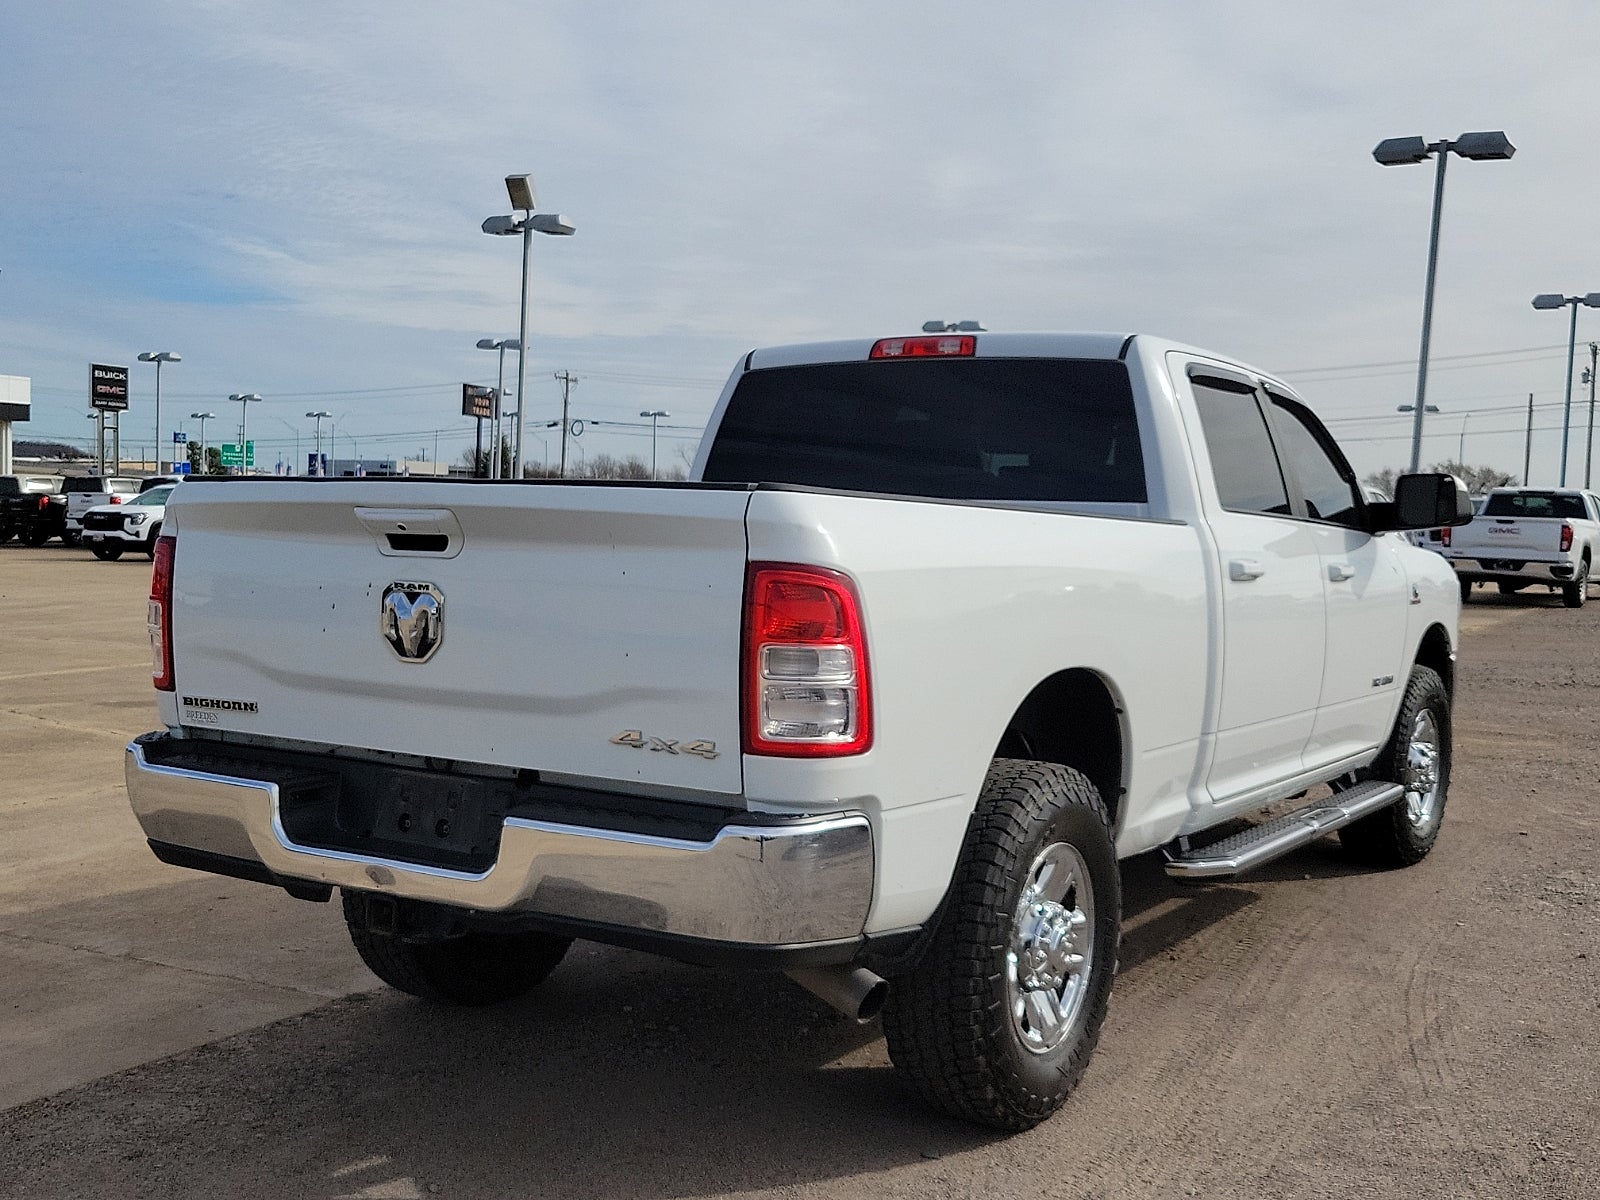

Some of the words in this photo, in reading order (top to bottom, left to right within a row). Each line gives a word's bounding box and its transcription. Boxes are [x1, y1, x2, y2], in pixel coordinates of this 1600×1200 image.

[94, 370, 127, 380] BUICK
[96, 384, 126, 394] GMC
[474, 397, 490, 406] YOUR
[472, 406, 491, 416] TRADE
[1488, 527, 1520, 535] GMC
[393, 582, 430, 591] RAM
[182, 697, 257, 712] BIGHORN
